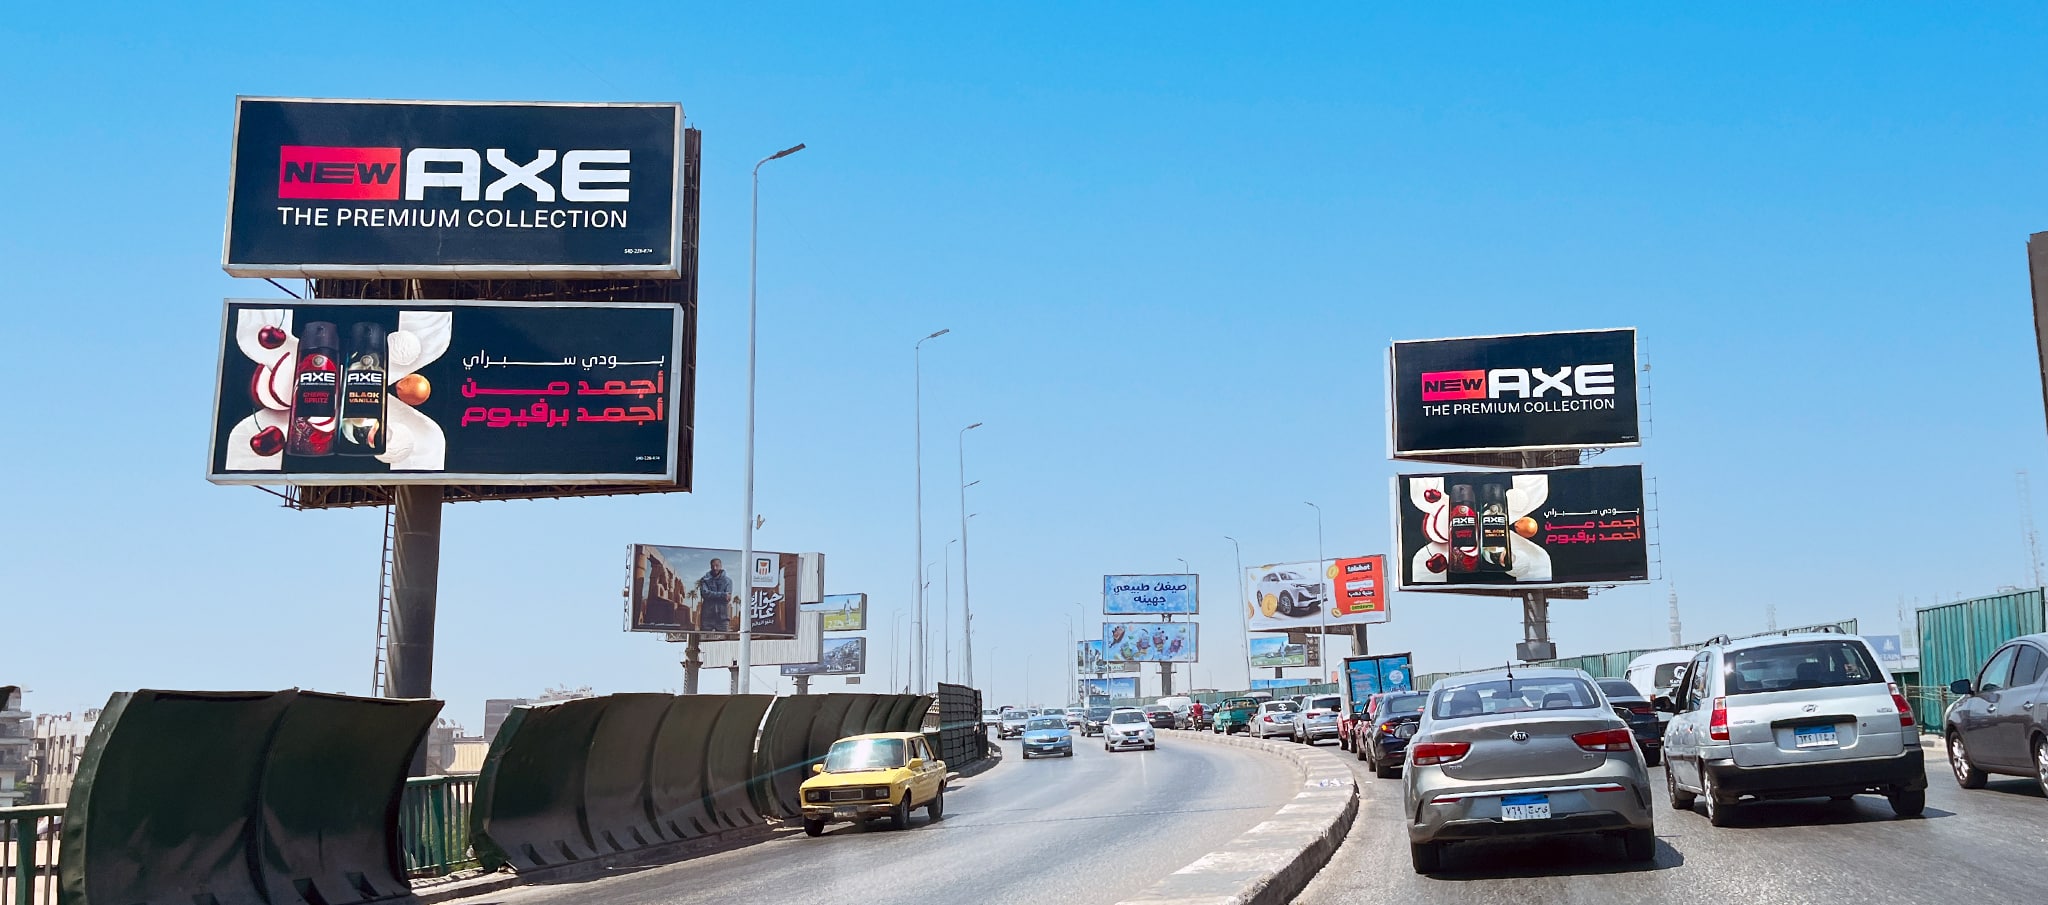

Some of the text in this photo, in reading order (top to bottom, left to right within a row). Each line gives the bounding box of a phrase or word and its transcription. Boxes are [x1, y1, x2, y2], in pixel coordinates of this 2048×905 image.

[284, 148, 630, 202] NEW AXE
[278, 206, 628, 230] THE PREMIUM COLLECTION
[462, 349, 665, 371] بودي سبراي
[300, 372, 336, 383] AXE
[347, 372, 382, 383] AXE
[461, 370, 664, 399] أجمد من
[1424, 364, 1615, 399] NEW AXE
[461, 397, 664, 428] أجمد برفيوم
[1423, 398, 1615, 417] THE PREMIUM COLLECTION
[1453, 516, 1475, 524] AXE
[1483, 516, 1505, 524] AXE
[1545, 529, 1597, 545] برفيوم
[1347, 563, 1371, 573] talabat
[1113, 581, 1188, 596] صيفك طبيعي
[1513, 731, 1528, 741] KIA
